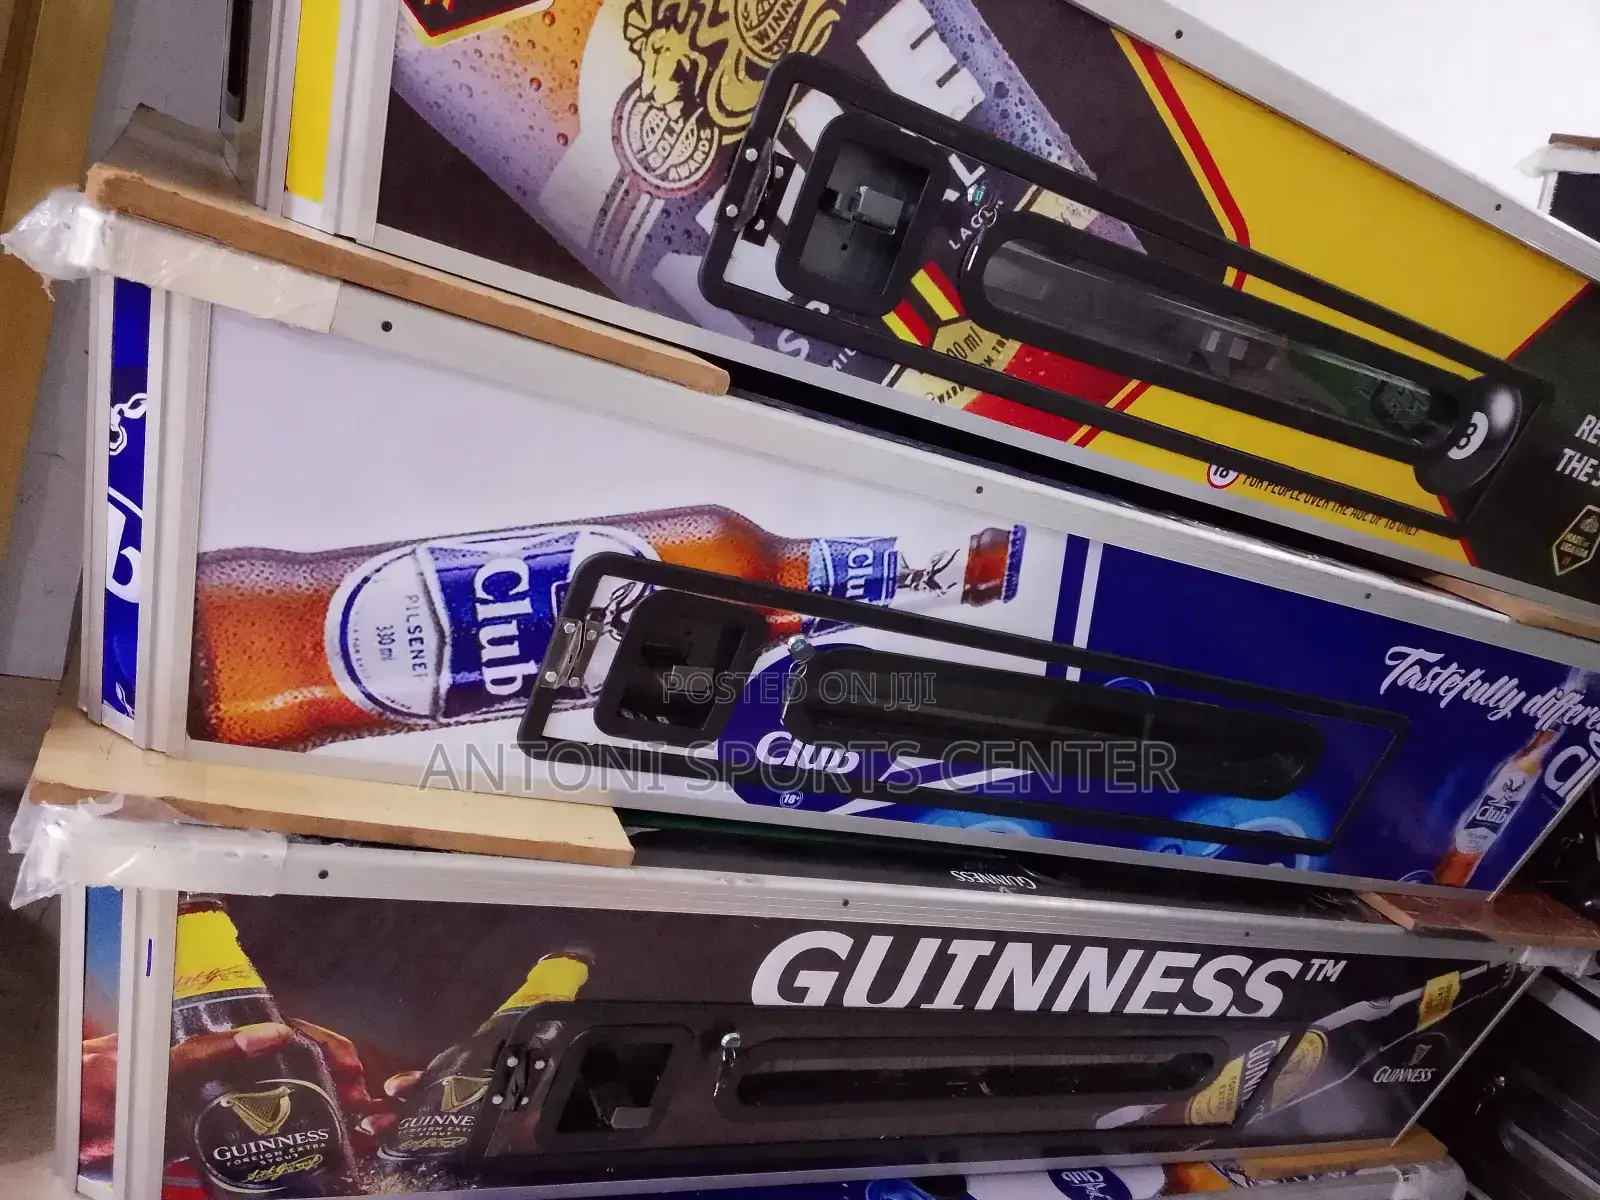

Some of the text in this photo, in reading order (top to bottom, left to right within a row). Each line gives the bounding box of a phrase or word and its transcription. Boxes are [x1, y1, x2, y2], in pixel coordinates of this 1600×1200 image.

[845, 546, 875, 599] Clu
[473, 555, 538, 697] Club
[1379, 645, 1527, 722] Tastefully
[949, 869, 1037, 890] GUINNESS
[751, 930, 1303, 1018] GUINNESS
[1373, 1065, 1436, 1083] GUINNESS
[398, 1114, 476, 1130] GUINNE
[212, 1128, 330, 1161] GUINNESS
[288, 1142, 327, 1155] EXTRA
[1060, 1169, 1104, 1184] Club
